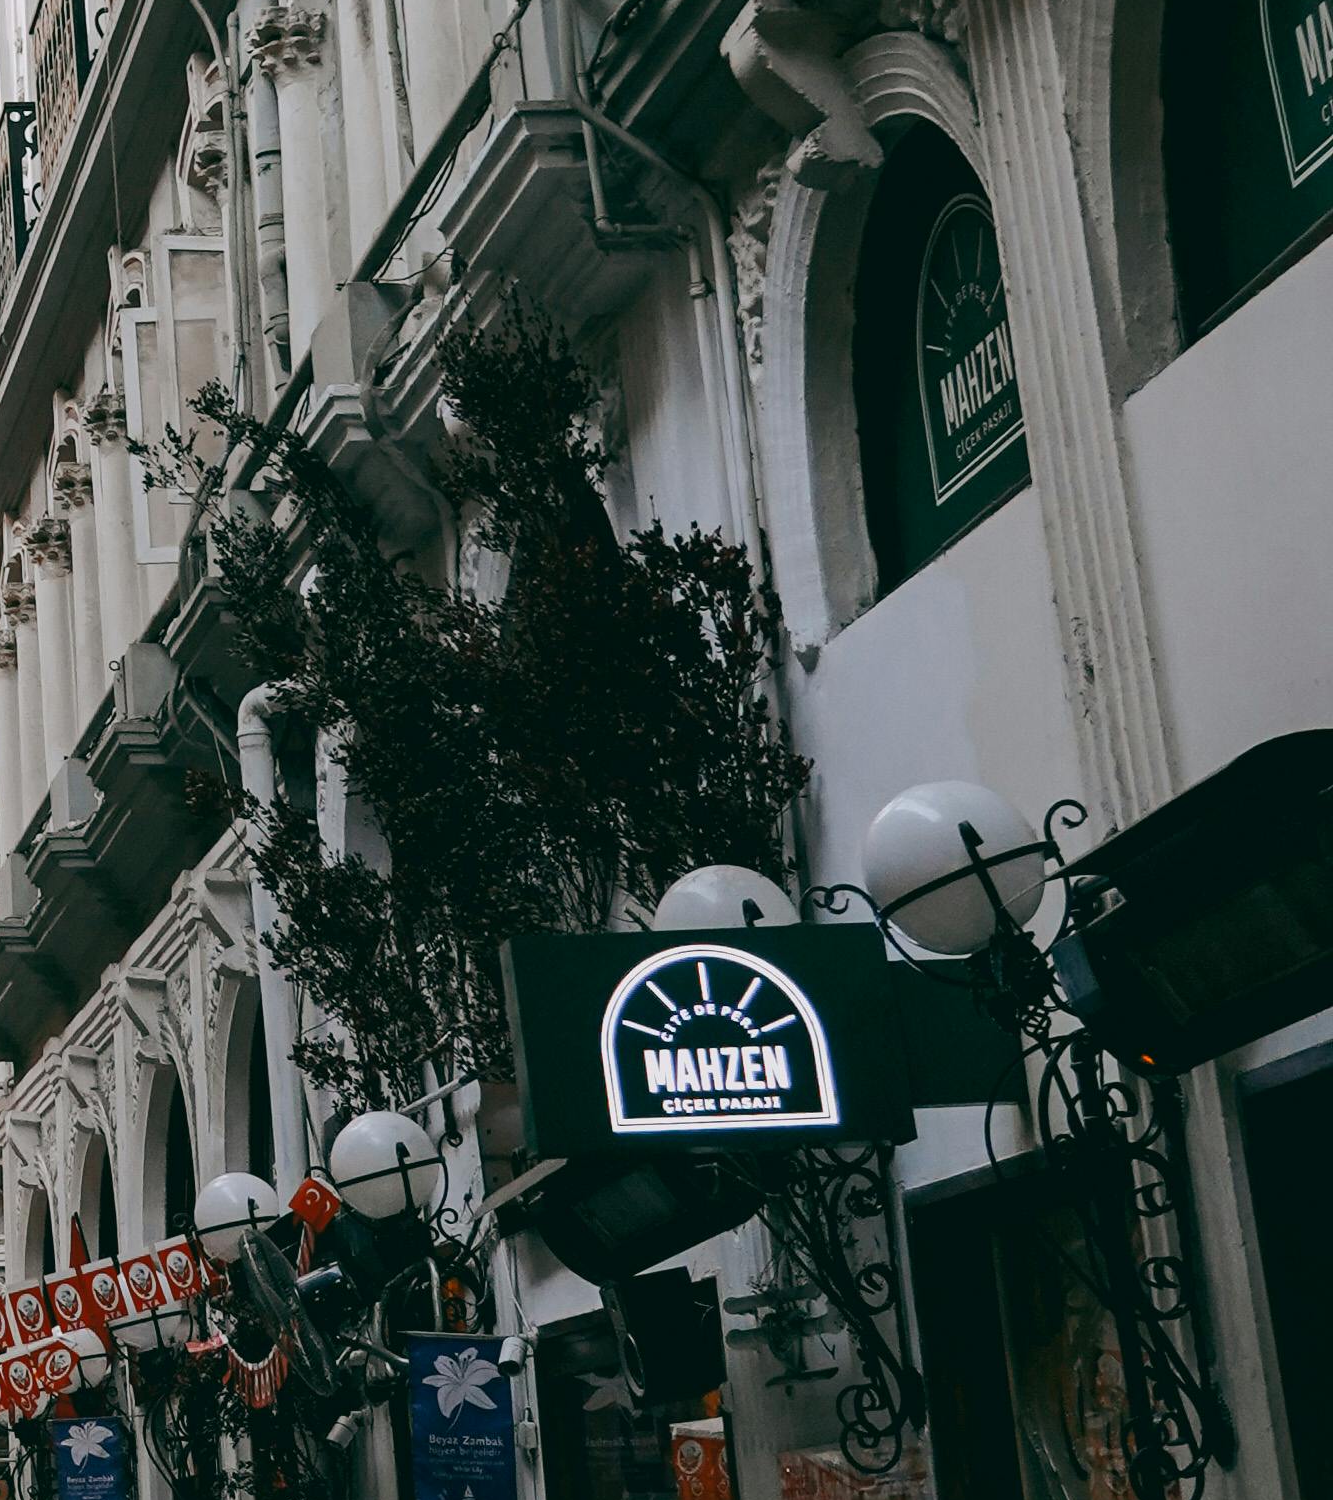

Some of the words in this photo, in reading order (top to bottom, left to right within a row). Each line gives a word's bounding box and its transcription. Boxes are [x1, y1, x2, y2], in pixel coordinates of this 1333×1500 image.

[940, 320, 1013, 437] MAHZEN
[983, 399, 1014, 436] PASAJI
[661, 1008, 691, 1042] CITE
[694, 1003, 717, 1016] DE
[720, 1005, 760, 1039] PERA
[643, 1045, 791, 1094] MAHZEN
[662, 1097, 717, 1114] ÇİÇEK
[719, 1096, 782, 1111] PASAJI
[179, 1288, 197, 1298] ATA
[141, 1301, 160, 1310] ATA
[104, 1311, 122, 1321] ATA
[67, 1320, 86, 1331] ATA
[27, 1332, 46, 1341] ATA
[429, 1434, 459, 1446] Beyaz
[462, 1435, 505, 1446] Zambak
